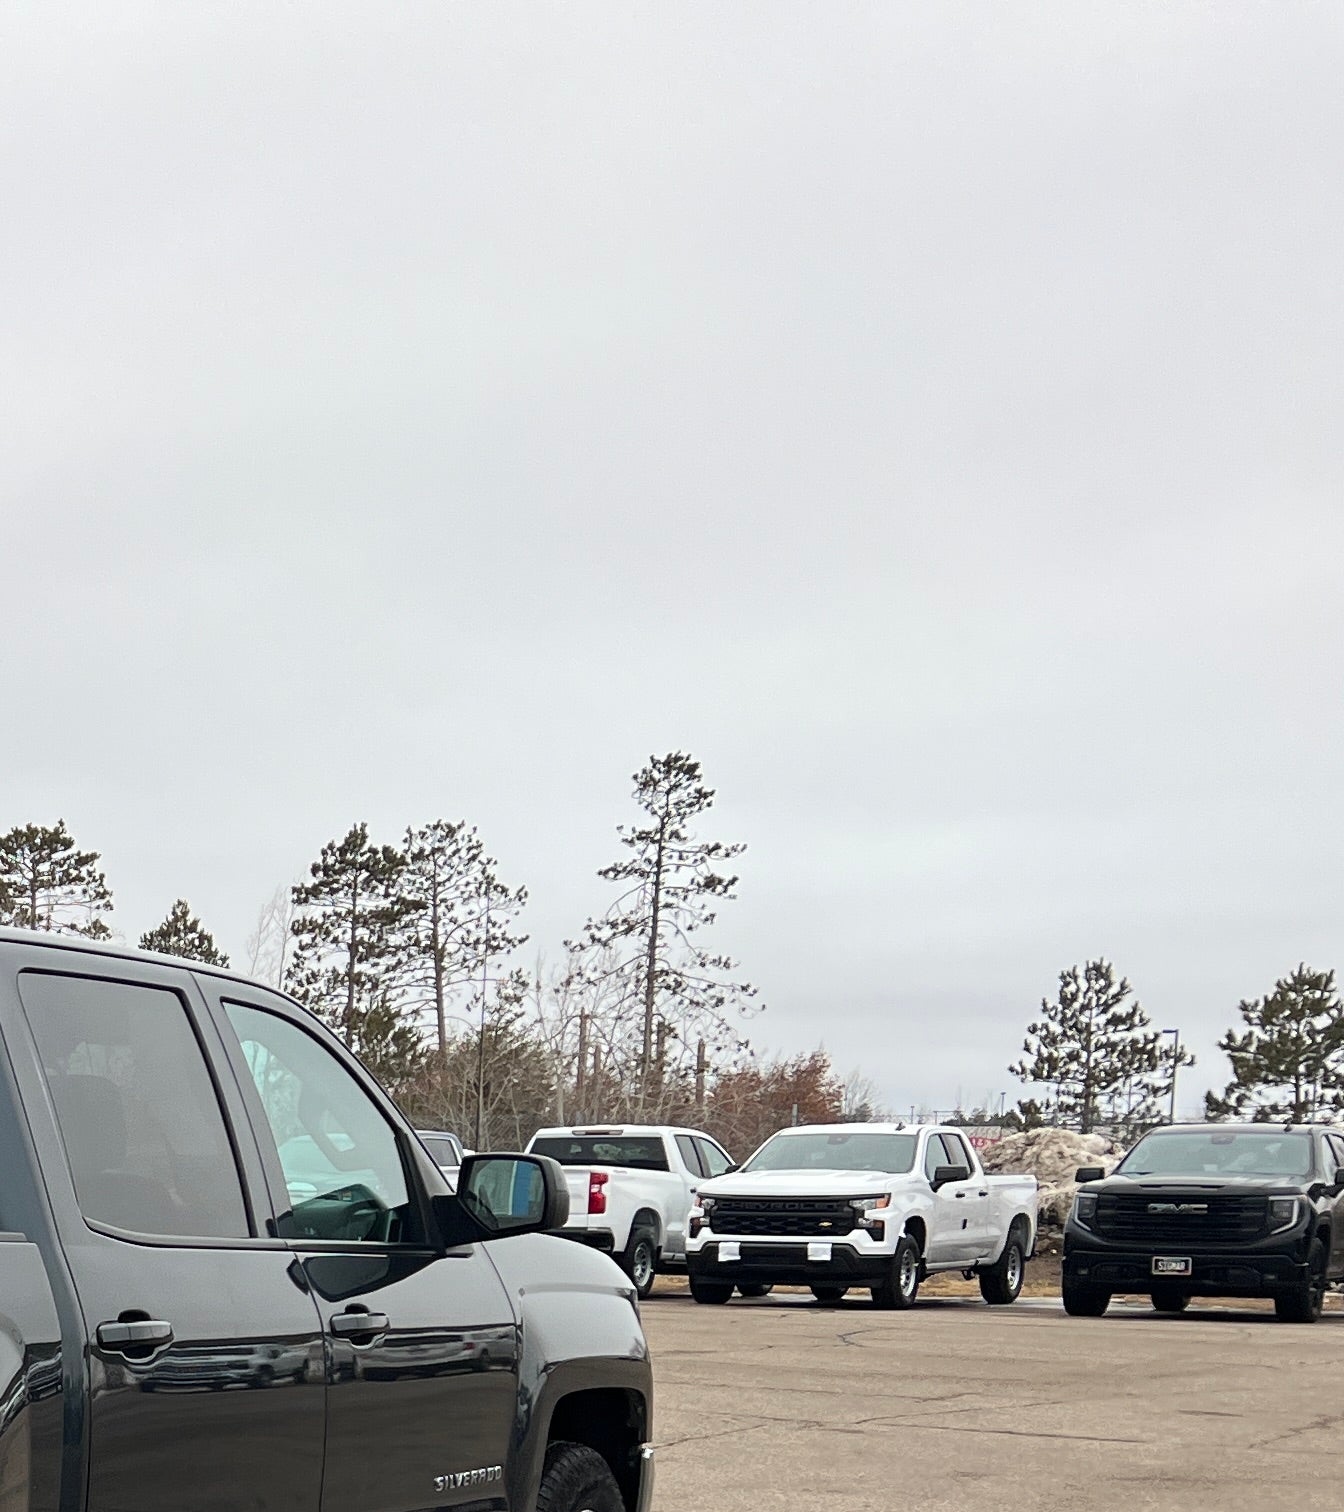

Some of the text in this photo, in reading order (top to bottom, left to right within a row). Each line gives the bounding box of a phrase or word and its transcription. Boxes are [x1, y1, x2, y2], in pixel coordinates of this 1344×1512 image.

[719, 1200, 840, 1210] CHEVROLET
[1148, 1203, 1208, 1214] GMC
[433, 1465, 502, 1491] SILVERADO
